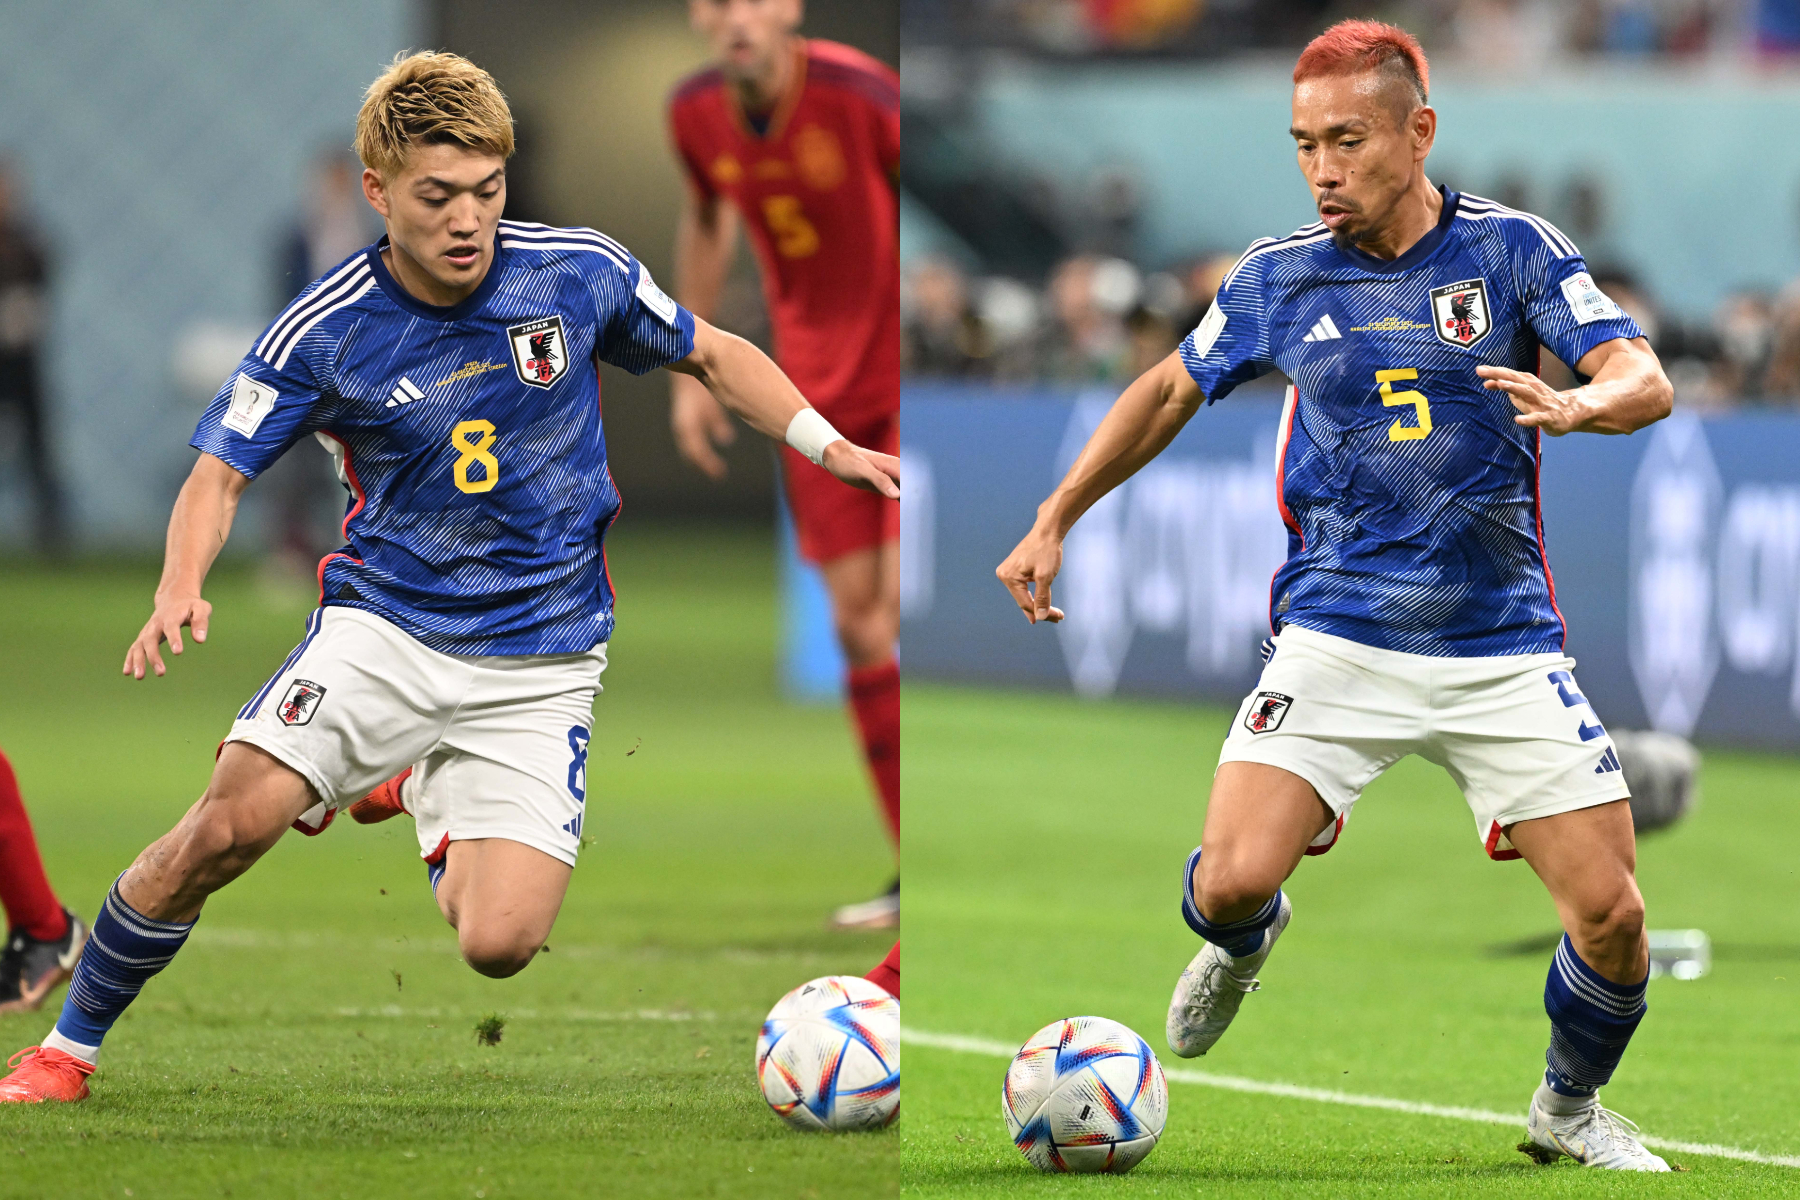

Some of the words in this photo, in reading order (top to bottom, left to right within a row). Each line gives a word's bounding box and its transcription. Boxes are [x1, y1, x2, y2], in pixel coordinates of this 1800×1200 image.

[764, 194, 820, 258] 5
[1443, 283, 1471, 294] JAPAN
[521, 321, 549, 333] JAPAN
[1453, 325, 1477, 338] JFA
[534, 365, 556, 379] JFA
[1375, 367, 1433, 442] 5
[451, 418, 499, 494] 8
[299, 680, 319, 690] JAPAN
[1264, 692, 1285, 700] JAPAN
[1547, 670, 1605, 742] 5
[282, 709, 300, 721] JFA
[1250, 719, 1268, 729] JFA
[567, 724, 591, 803] 8
